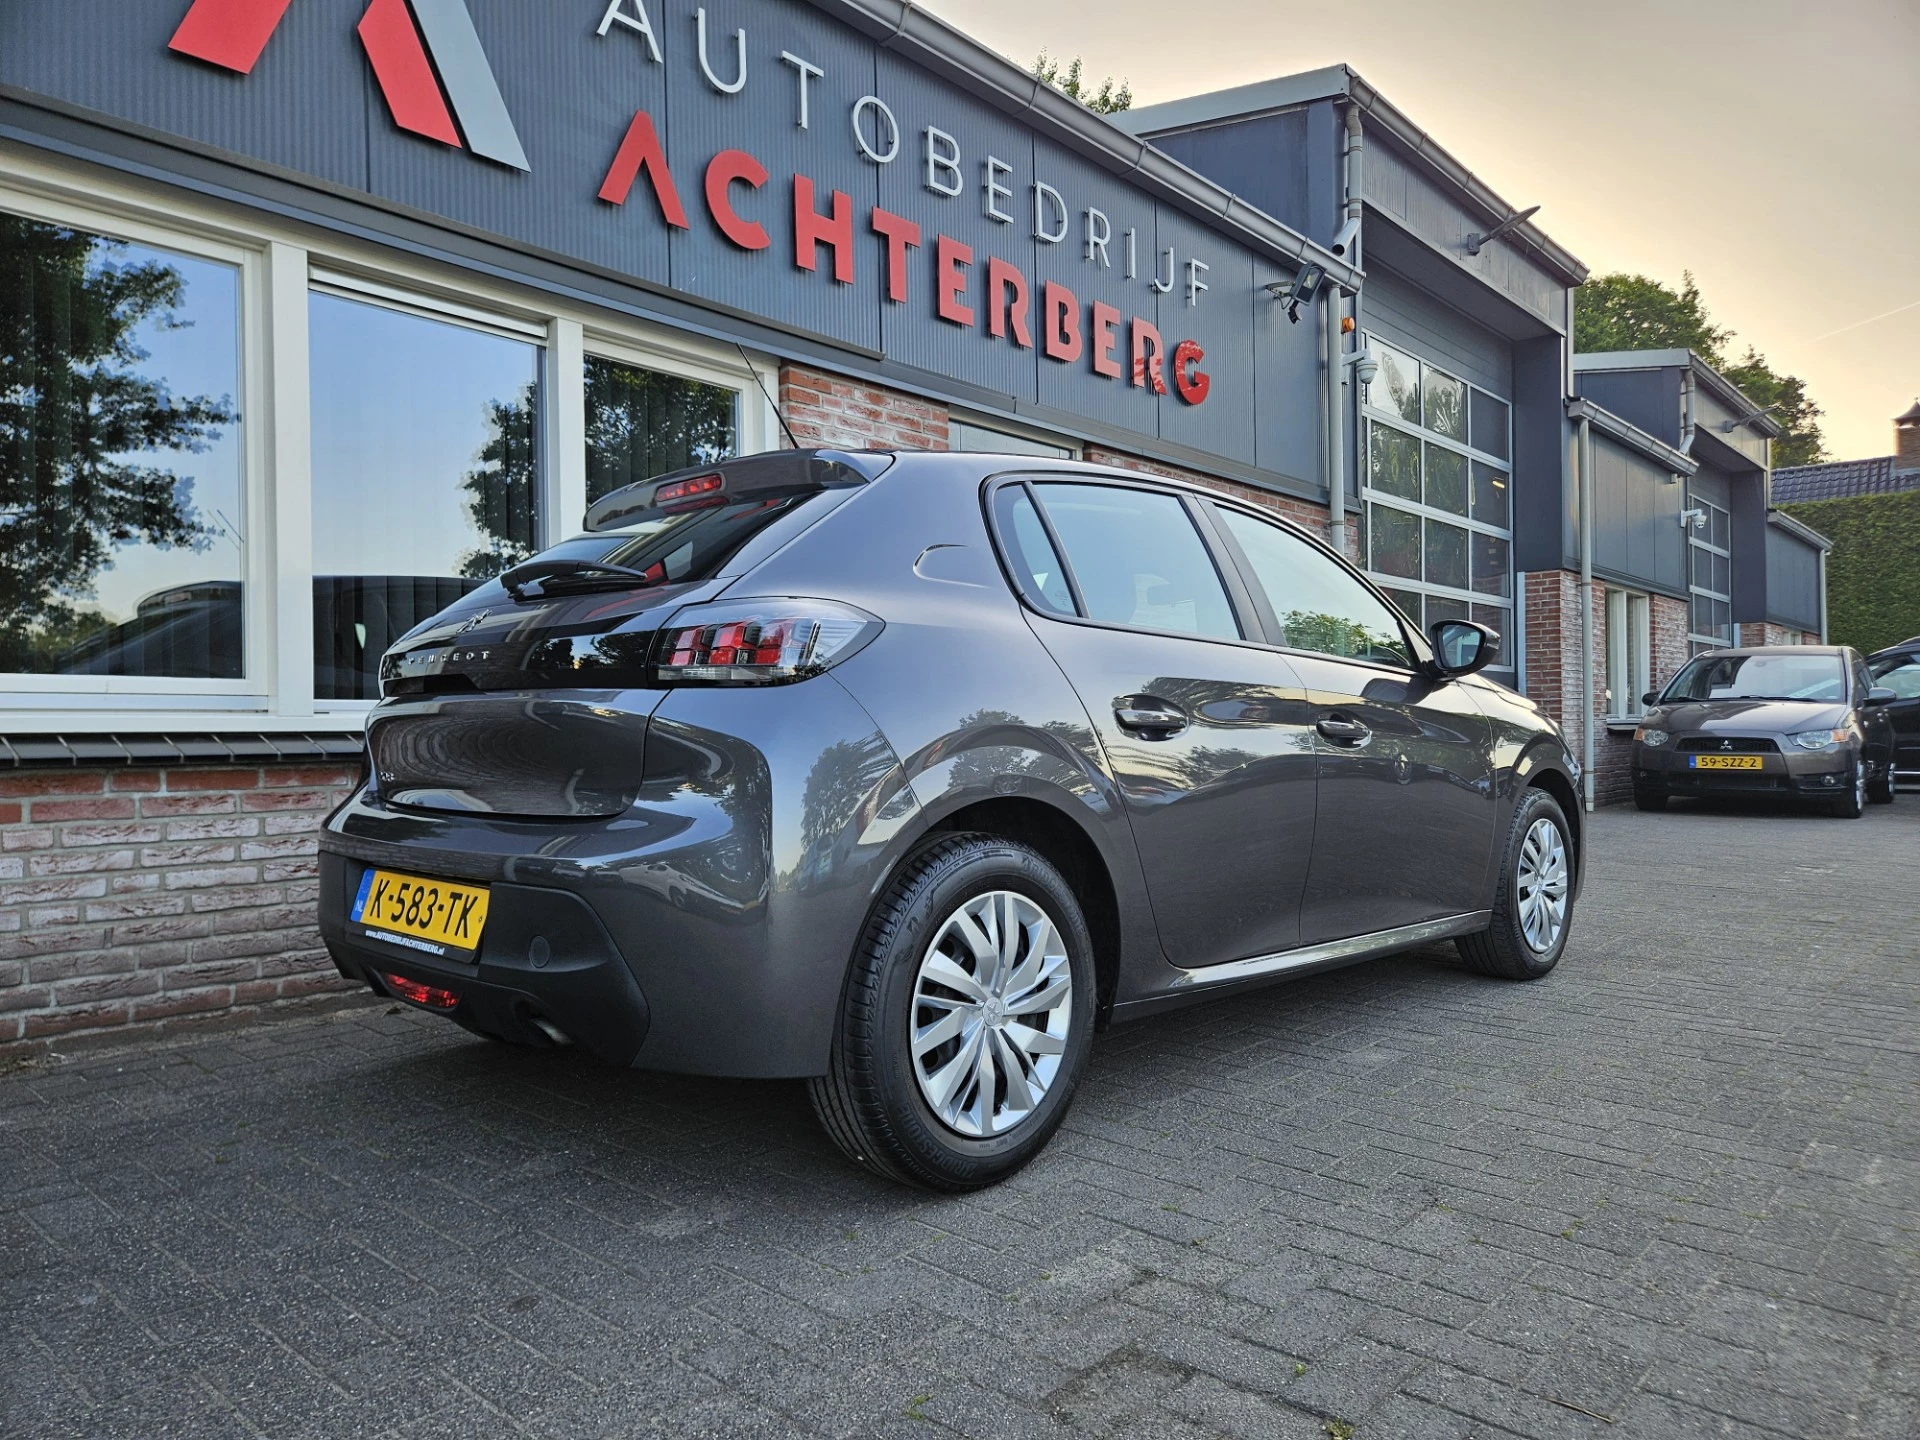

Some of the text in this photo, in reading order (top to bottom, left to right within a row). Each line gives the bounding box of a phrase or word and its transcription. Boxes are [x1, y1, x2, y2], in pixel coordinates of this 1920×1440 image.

[597, 0, 1209, 306] AUTOBEDRIJF
[597, 110, 1210, 405] ACHTERBERG
[408, 651, 490, 665] PEUGEOT
[1701, 757, 1757, 768] 59-SZZ-2
[369, 878, 479, 939] K-583-TK
